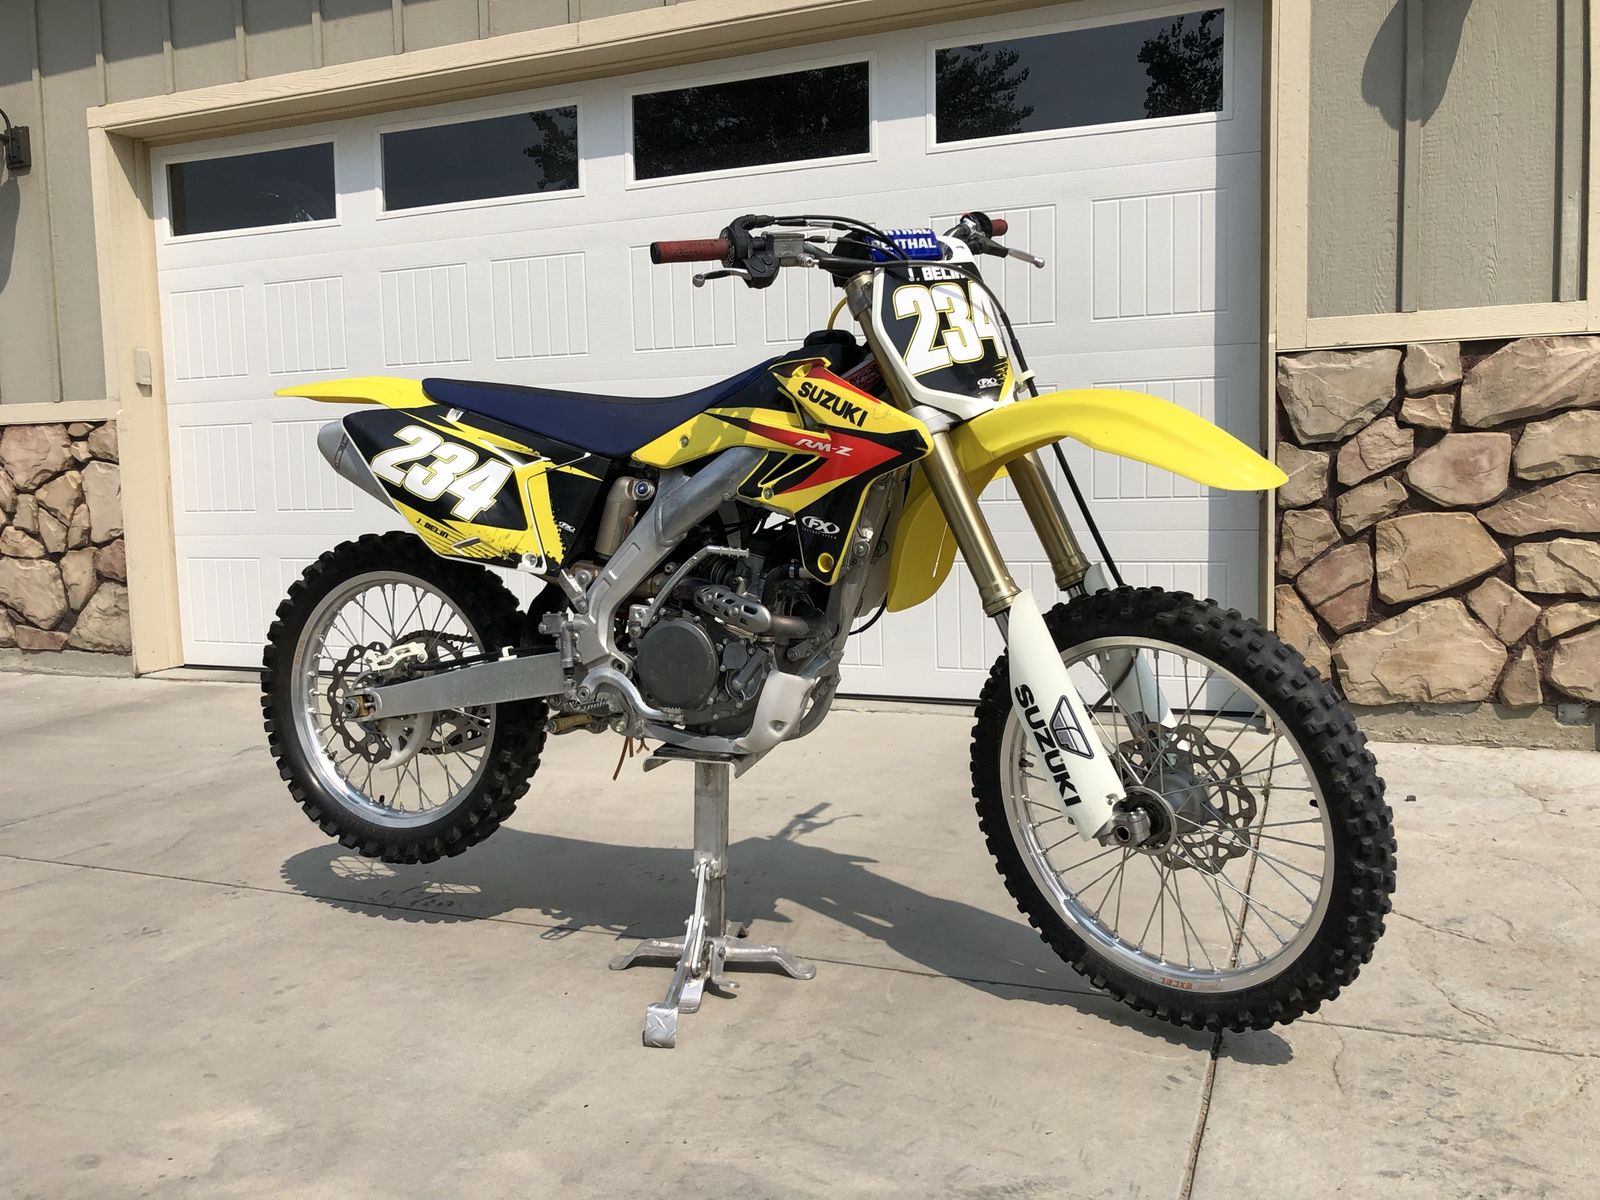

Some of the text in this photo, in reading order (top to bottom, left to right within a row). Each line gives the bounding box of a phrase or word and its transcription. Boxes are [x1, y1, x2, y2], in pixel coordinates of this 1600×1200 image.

[893, 281, 1006, 377] 234
[794, 438, 854, 456] RM-Z
[797, 382, 869, 427] SUZUKI
[370, 425, 515, 523] 234
[1014, 684, 1082, 807] SUZUKI
